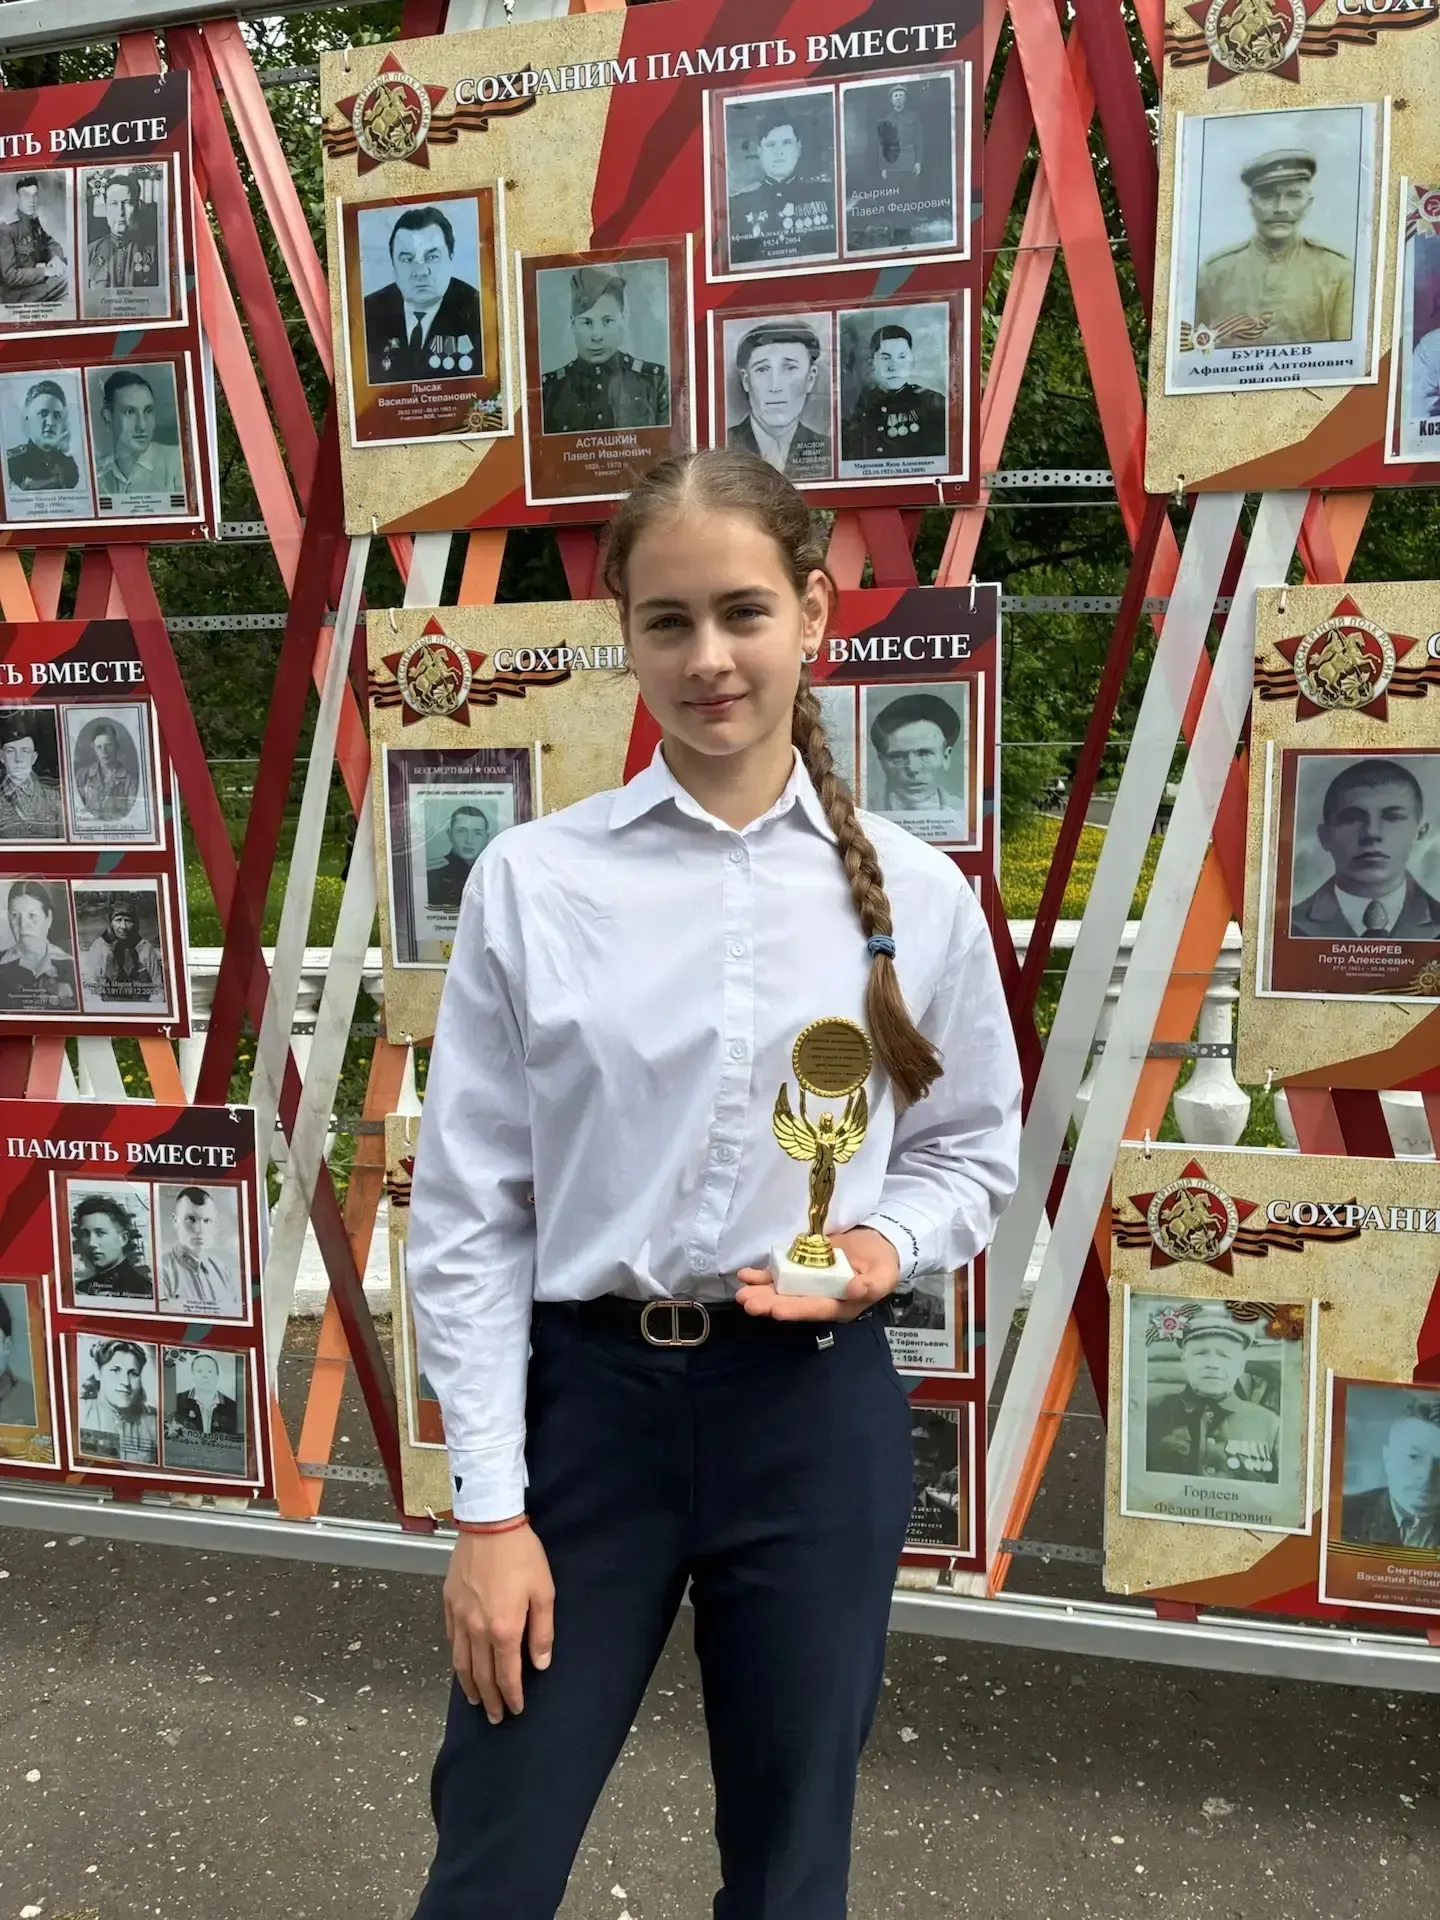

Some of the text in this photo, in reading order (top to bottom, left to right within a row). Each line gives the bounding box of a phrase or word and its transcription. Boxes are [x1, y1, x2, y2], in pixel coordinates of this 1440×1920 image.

[453, 21, 959, 105] СОХРАНИМ ПАМЯТЬ ВМЕСТЕ
[0, 117, 168, 159] ТЬ ВМЕСТЕ
[851, 187, 900, 200] Асыркин
[851, 198, 951, 216] Павел Федорович
[1231, 346, 1313, 360] БУРНАЕВ
[1189, 358, 1354, 376] Афанасий Антонович
[411, 384, 442, 393] Лысак
[378, 392, 478, 407] Василий Степанович
[576, 434, 638, 449] АСТАШКИН
[563, 447, 652, 462] Павел Иванович
[827, 634, 972, 663] ВМЕСТЕ
[1349, 617, 1378, 636] ПОЛК
[1377, 633, 1394, 680] РОССИИ
[29, 660, 145, 684] ВМЕСТЕ
[1331, 943, 1403, 955] БАЛАКИРЕВ
[1318, 954, 1415, 966] Петр Алексеевич
[6, 1137, 237, 1168] ПАМЯТЬ ВМЕСТЕ
[1196, 1180, 1225, 1197] ПОЛК
[1266, 1199, 1440, 1234] СОХРАНИ
[889, 1330, 919, 1338] Егоров
[895, 1338, 949, 1347] Терентьевич
[903, 1354, 923, 1363] 1984
[1183, 1484, 1240, 1501] Гордеев
[1153, 1501, 1273, 1525] Фёдор Петрович
[1356, 1571, 1406, 1584] Василий
